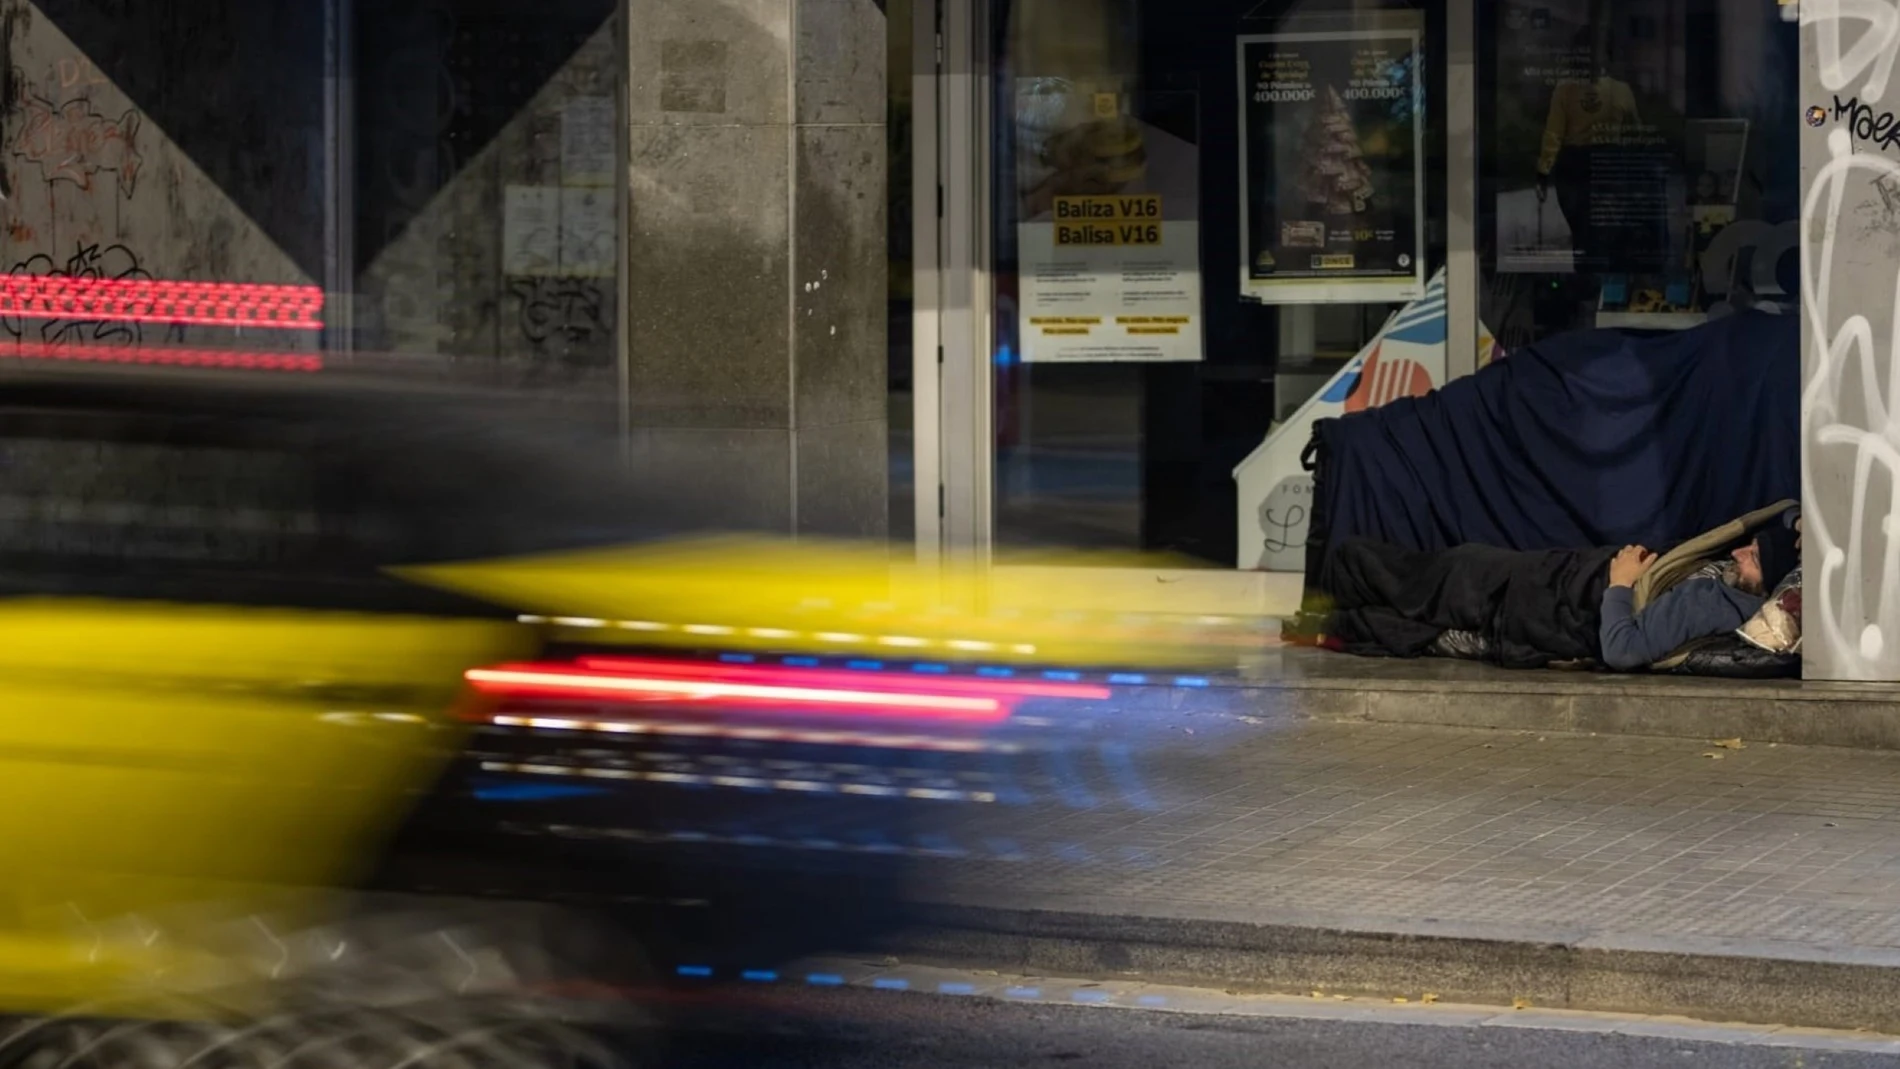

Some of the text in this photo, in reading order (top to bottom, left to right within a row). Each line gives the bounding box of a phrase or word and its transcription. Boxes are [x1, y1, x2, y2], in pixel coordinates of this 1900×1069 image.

[1056, 199, 1158, 218] Baliza V16
[1058, 225, 1158, 244] Balisa V16
